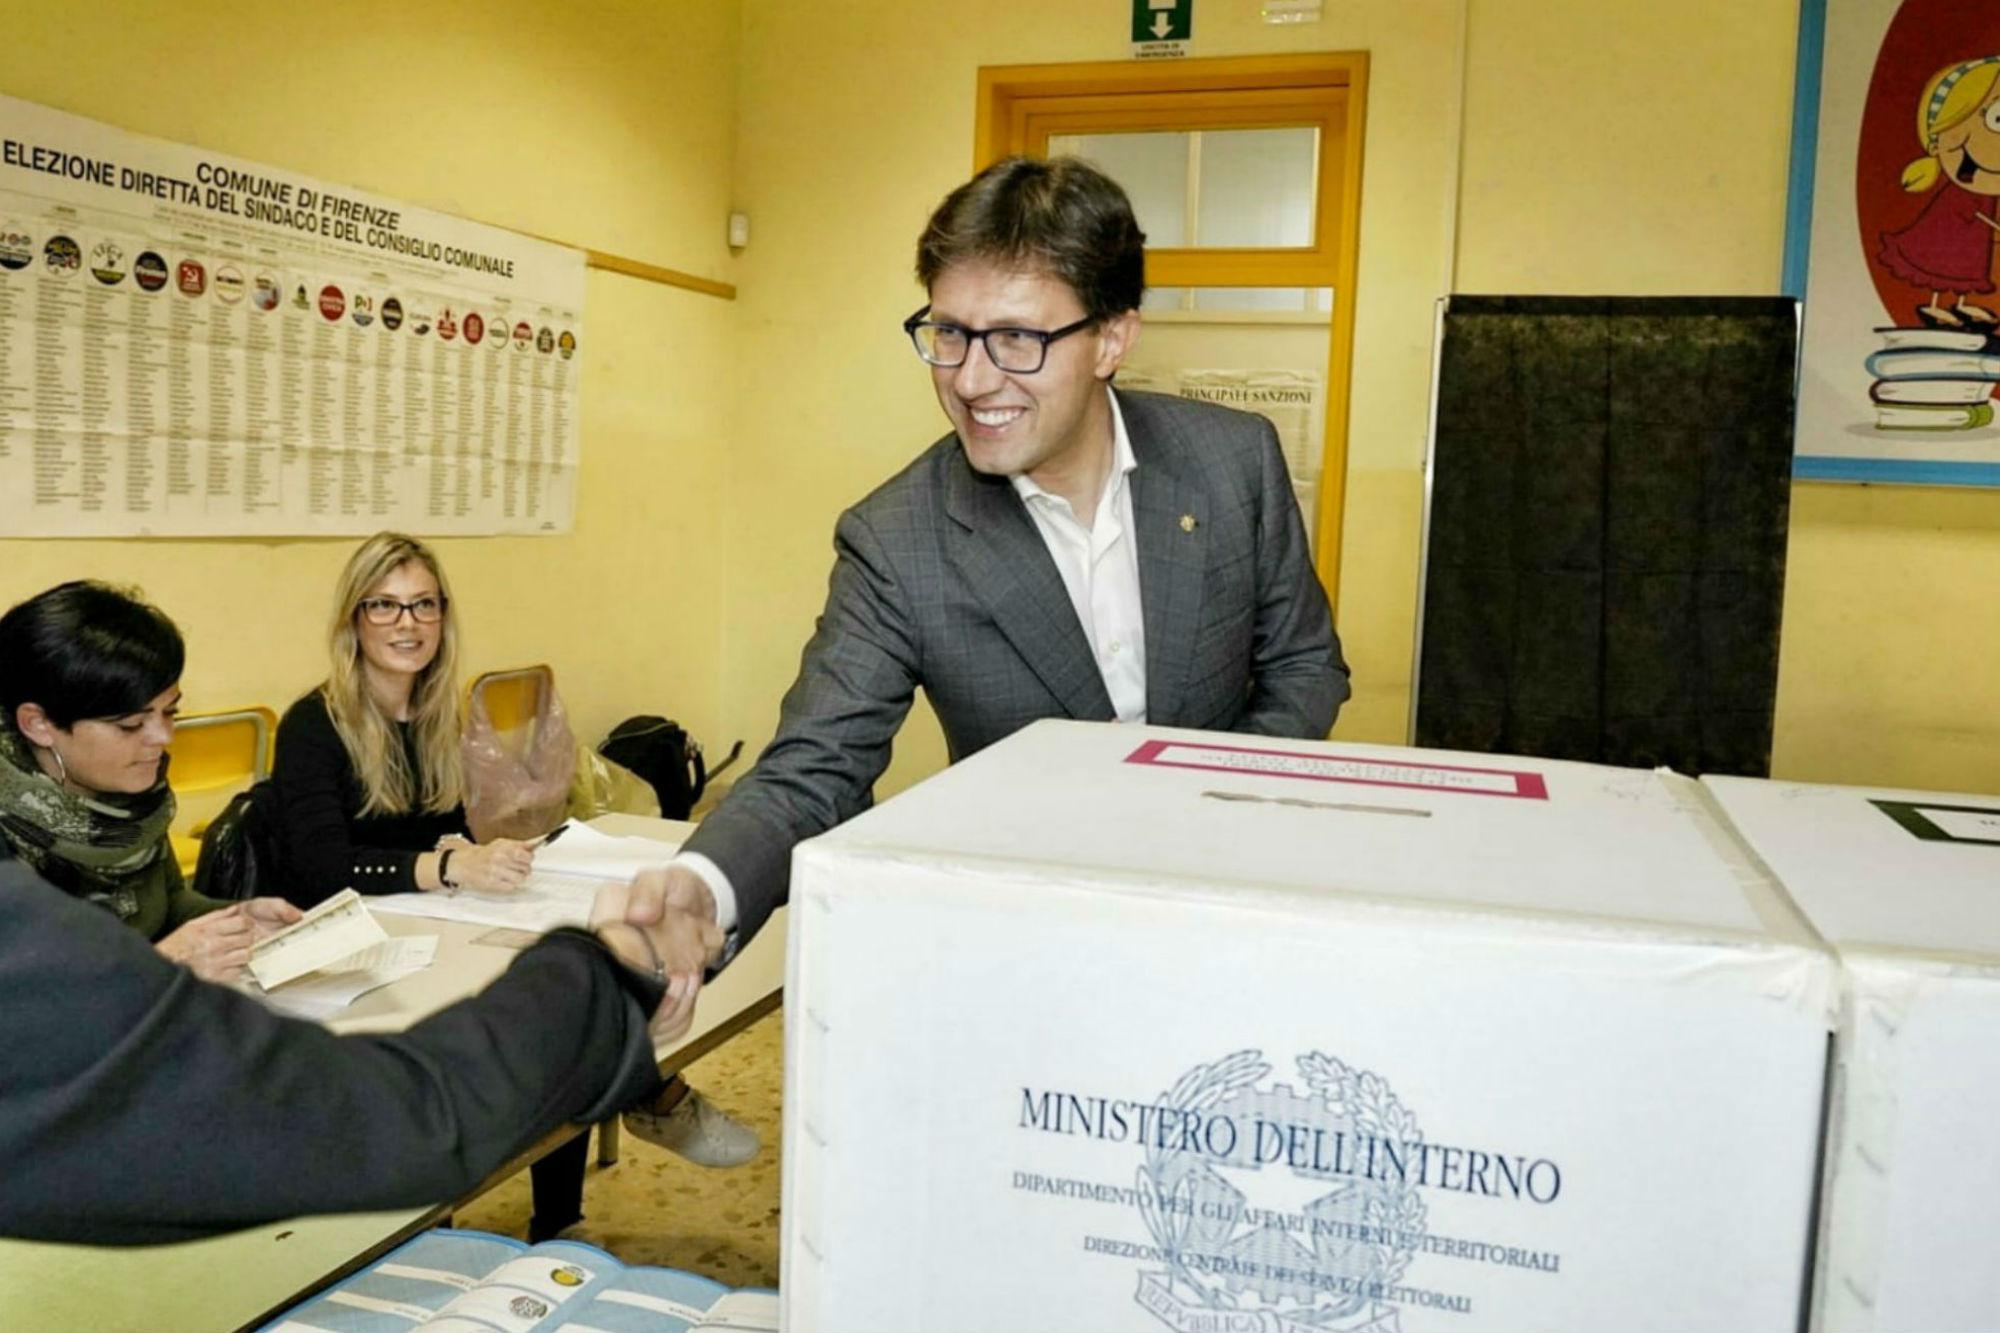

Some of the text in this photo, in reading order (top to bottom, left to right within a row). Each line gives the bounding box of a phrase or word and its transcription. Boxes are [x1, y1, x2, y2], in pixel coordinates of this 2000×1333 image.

[3, 140, 115, 188] ELEZIONE
[121, 168, 200, 207] DIRETTA
[206, 189, 239, 216] DEL
[245, 198, 317, 232] SINDACO
[321, 217, 330, 236] E
[334, 220, 362, 244] DEL
[367, 228, 442, 262] CONSIGLIO
[445, 247, 514, 278] COMUNALE
[196, 163, 400, 231] COMUNE DI FIRENZE
[1253, 390, 1312, 404] SANZIONI
[1018, 1087, 1561, 1204] MINISTERO DELL'INTERNO
[1013, 1171, 1150, 1209] DIPARTIMENTO
[1158, 1193, 1194, 1218] PER
[1201, 1200, 1233, 1221] GLI
[1243, 1207, 1305, 1233] AFFARI
[1312, 1217, 1393, 1246] INTERNI
[1421, 1234, 1561, 1274] TERRITORIALI
[1084, 1235, 1472, 1314] DIREZIONE CENTRALE DEI SERVIZI ELETTORALI
